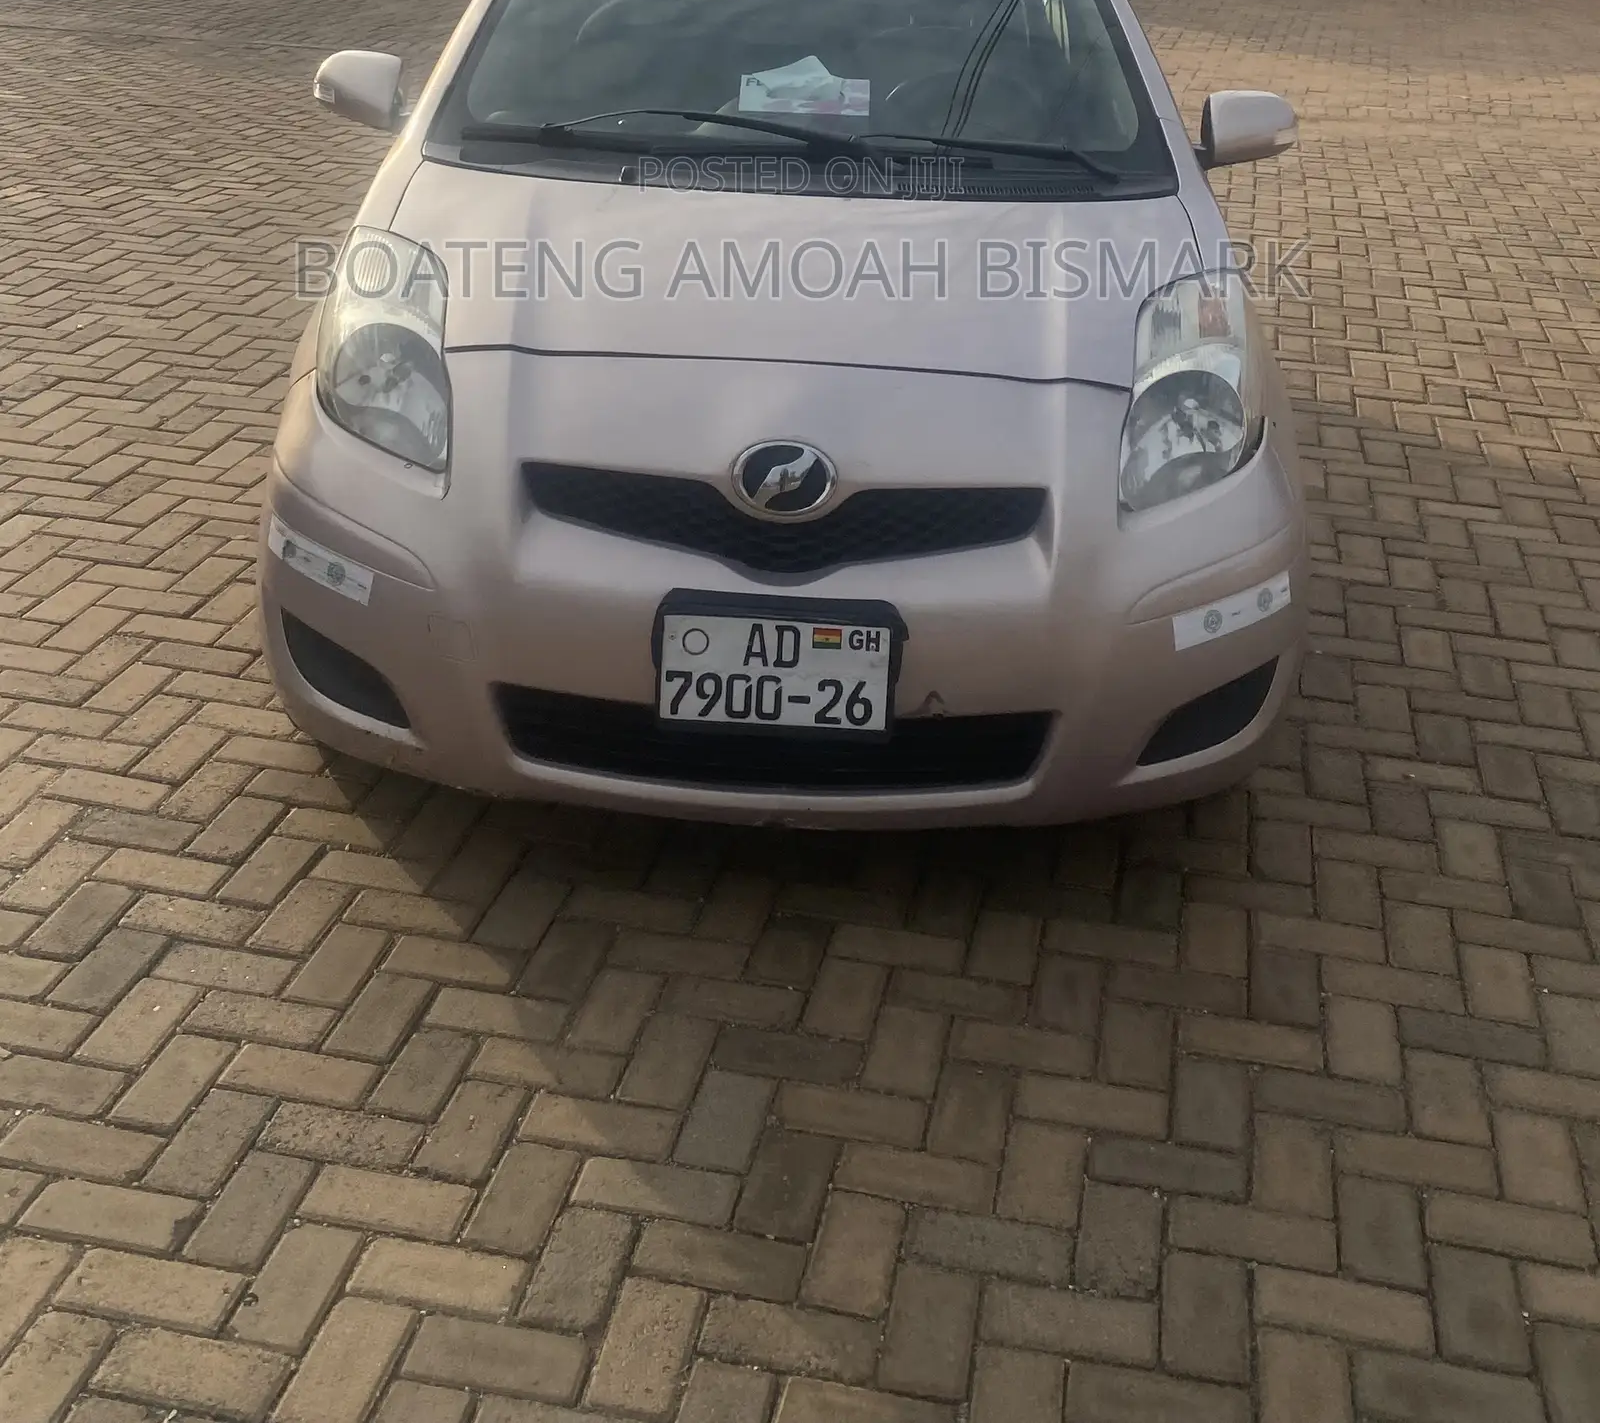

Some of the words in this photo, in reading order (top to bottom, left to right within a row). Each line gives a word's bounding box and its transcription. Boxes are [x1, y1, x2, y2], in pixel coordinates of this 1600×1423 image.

[742, 622, 801, 669] AD
[848, 629, 881, 653] GH
[665, 669, 873, 727] 7900-26
